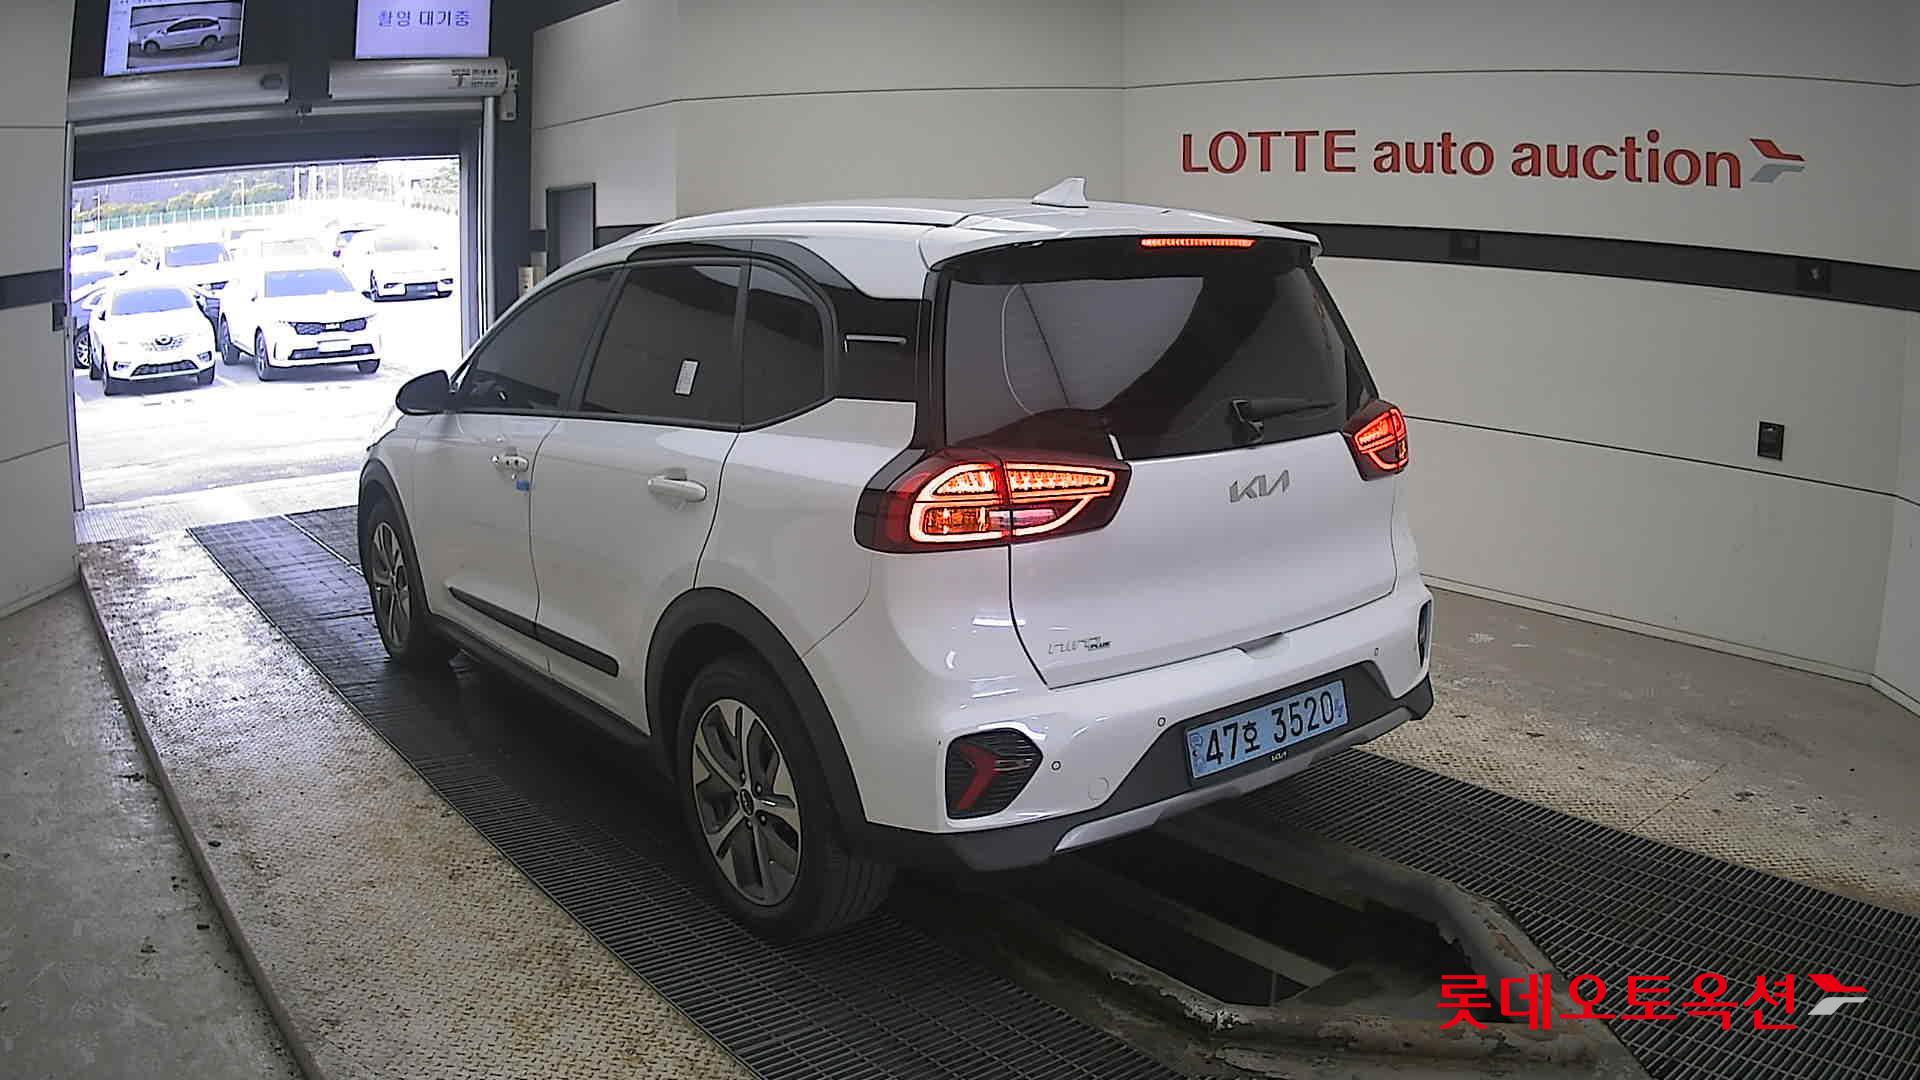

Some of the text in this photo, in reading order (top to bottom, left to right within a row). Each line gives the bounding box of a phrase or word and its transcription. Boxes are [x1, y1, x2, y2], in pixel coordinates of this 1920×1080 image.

[419, 10, 469, 27] 대기중
[1182, 129, 1742, 189] LOTTE auto auction
[1206, 722, 1260, 766] 47호
[1271, 691, 1334, 744] 3520
